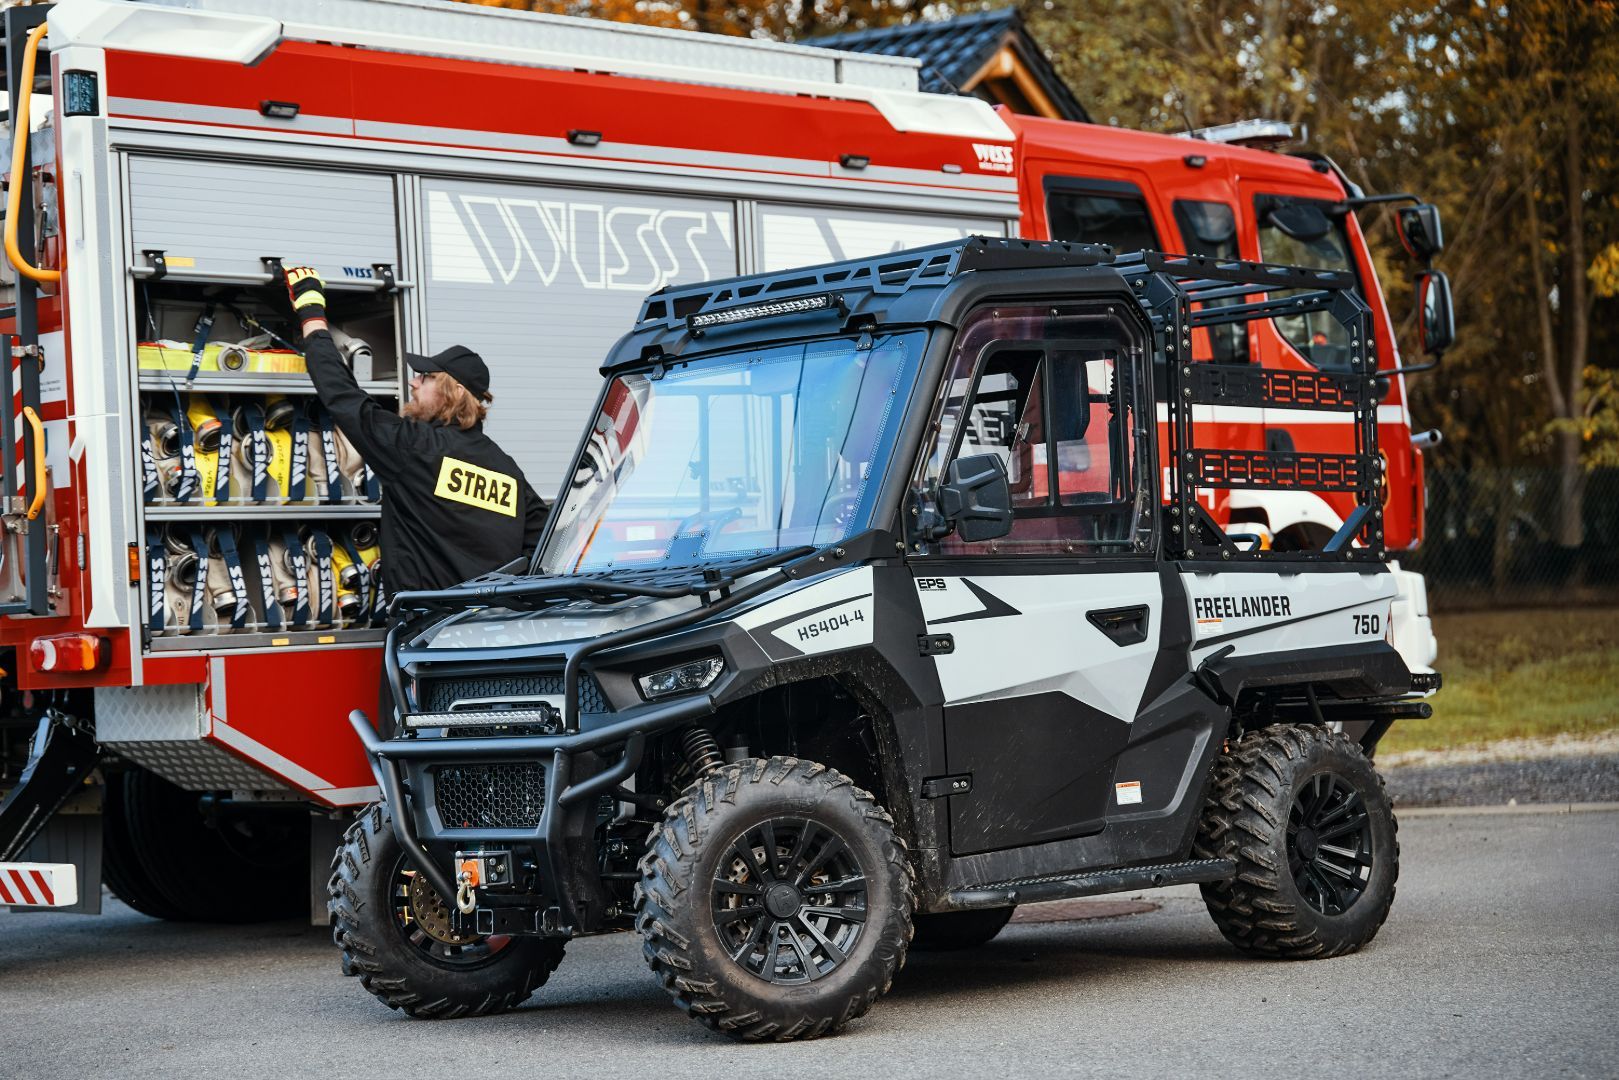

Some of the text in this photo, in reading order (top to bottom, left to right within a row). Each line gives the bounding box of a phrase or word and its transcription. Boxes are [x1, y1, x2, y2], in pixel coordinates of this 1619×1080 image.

[459, 194, 708, 290] WISS
[343, 266, 372, 278] WISS
[141, 439, 159, 494] WISS
[177, 444, 197, 499] WISS
[217, 433, 232, 491] WISS
[253, 430, 267, 486] WISS
[292, 432, 308, 486] WISS
[322, 430, 340, 485] WISS
[151, 558, 164, 617] WISS
[192, 558, 208, 615] WISS
[229, 565, 248, 622] WISS
[257, 554, 275, 610] WISS
[292, 555, 308, 611] WISS
[319, 557, 332, 613] WISS
[356, 563, 370, 616] WISS
[917, 579, 946, 589] EPS
[1194, 596, 1292, 619] FREELANDER
[797, 609, 864, 641] HS404-4
[1353, 614, 1380, 635] 750
